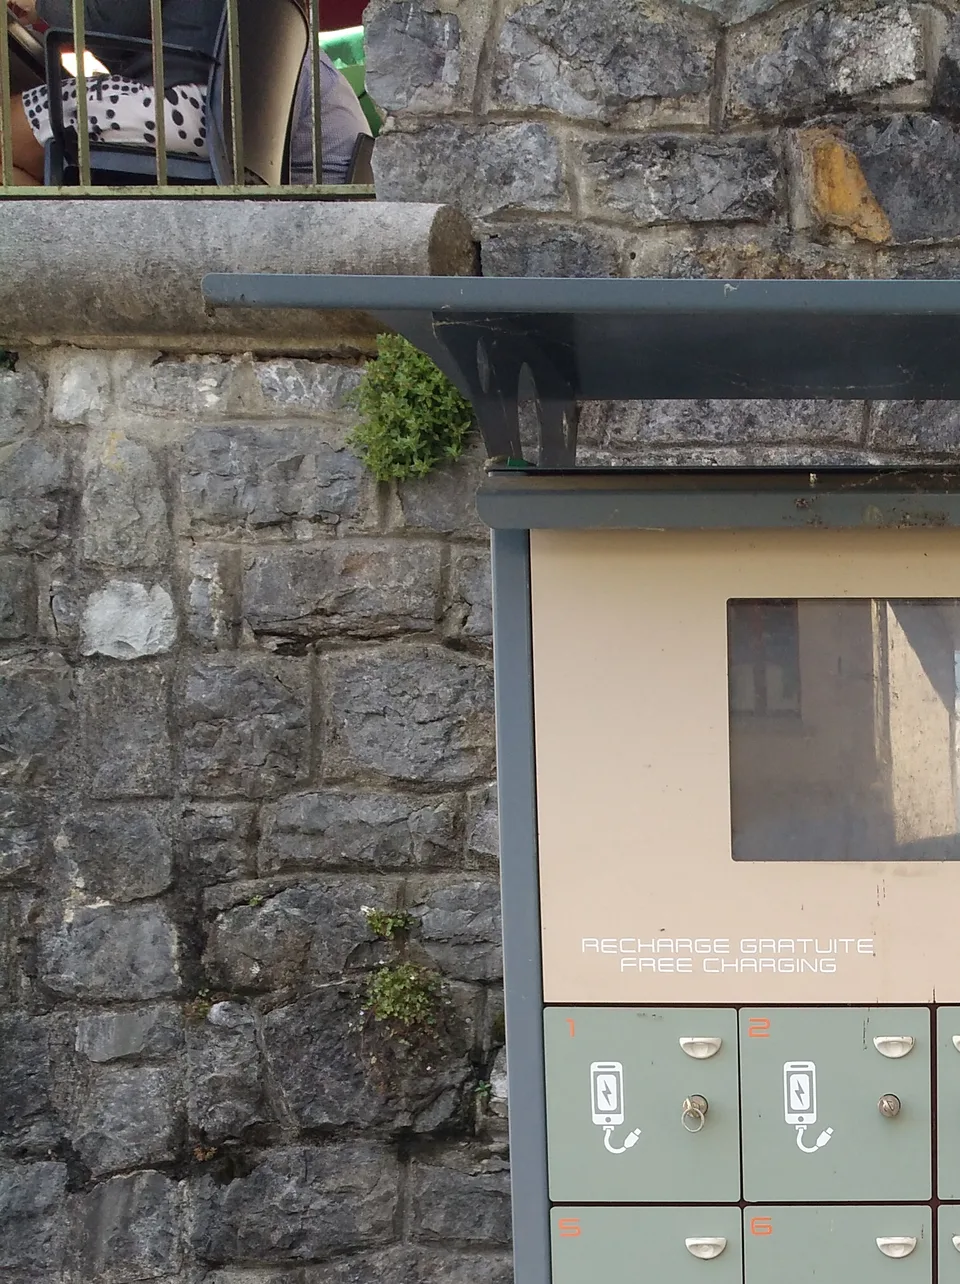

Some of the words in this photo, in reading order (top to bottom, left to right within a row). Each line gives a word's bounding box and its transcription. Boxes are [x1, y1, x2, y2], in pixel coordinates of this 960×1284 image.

[581, 937, 730, 954] RECHARGE
[740, 937, 874, 954] GRATUITE
[620, 957, 693, 973] FREE
[703, 957, 837, 973] CHARGING
[565, 1017, 575, 1038] 1
[747, 1017, 771, 1039] 2
[557, 1217, 582, 1238] 5
[749, 1216, 774, 1237] 6
